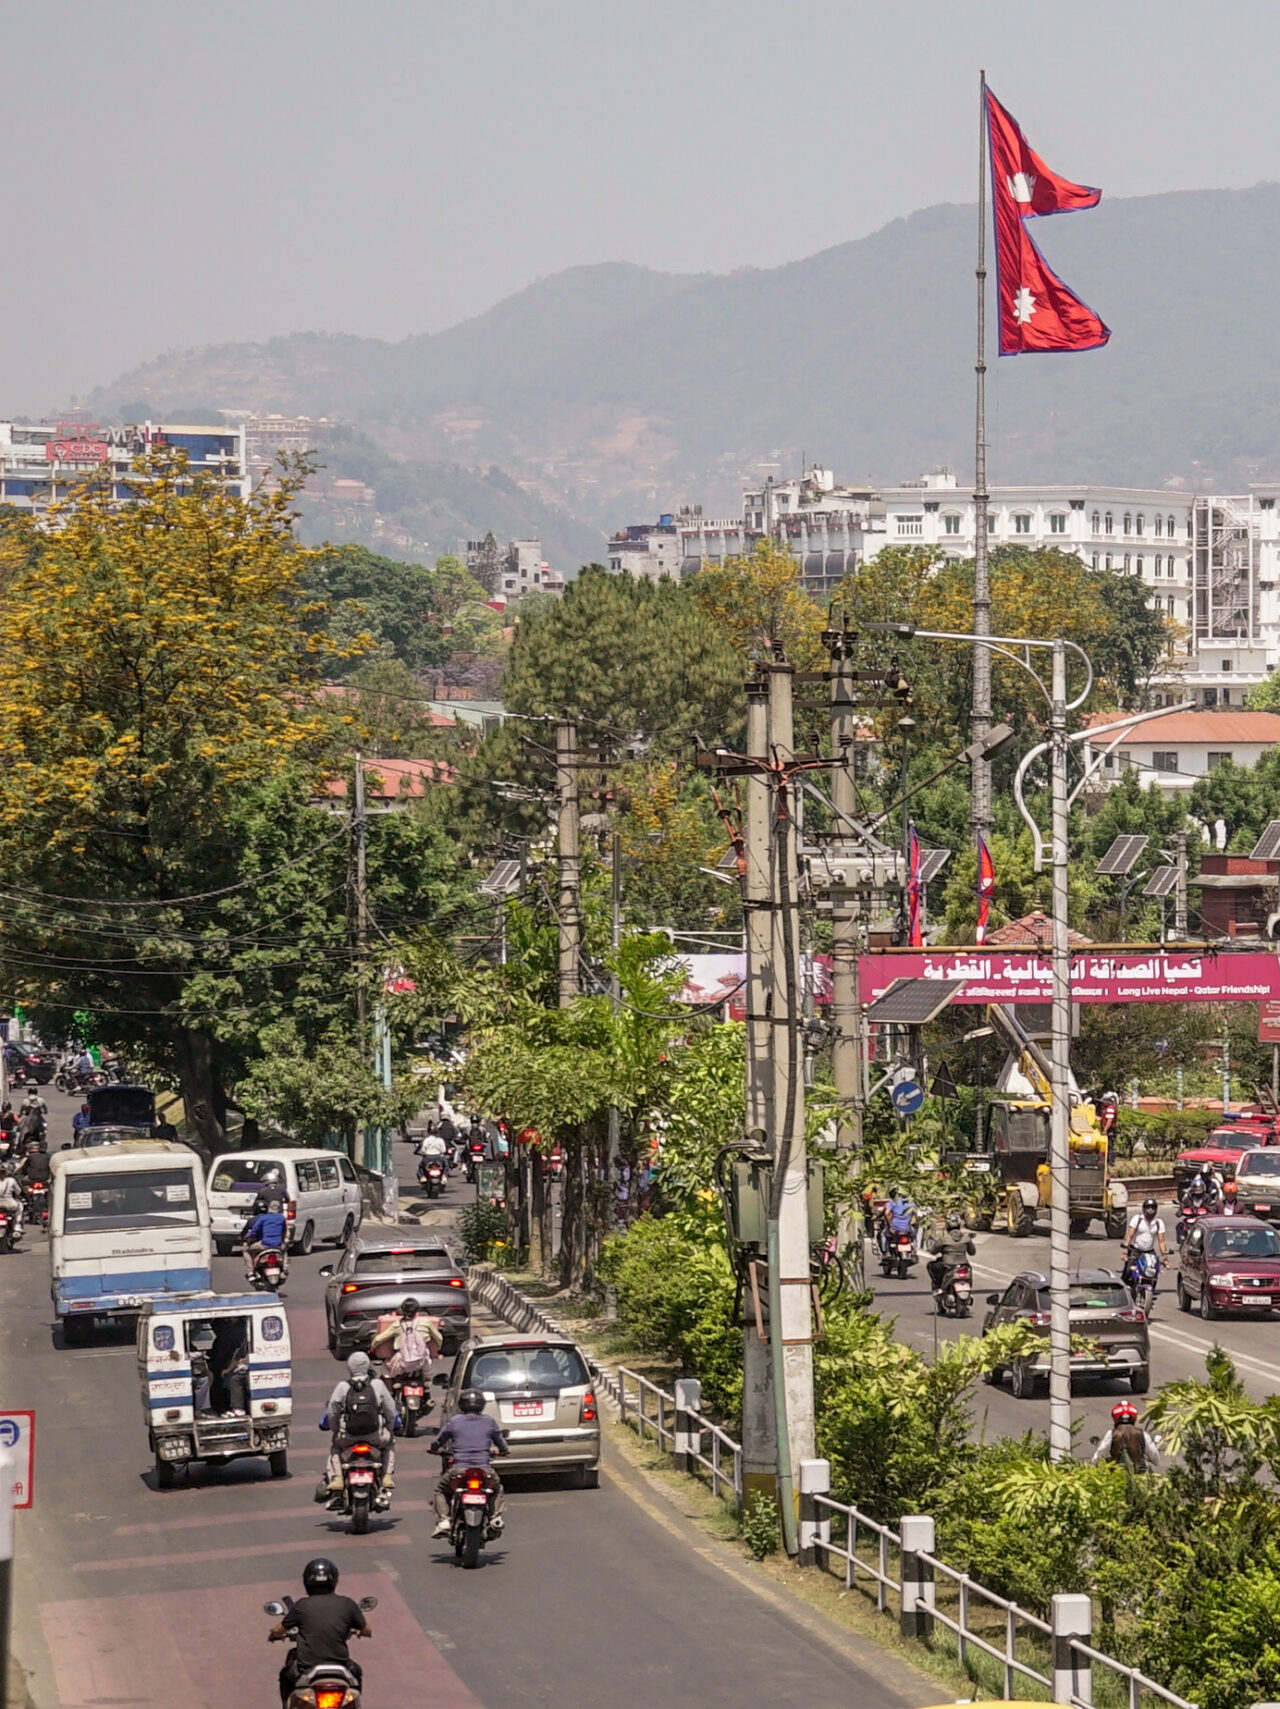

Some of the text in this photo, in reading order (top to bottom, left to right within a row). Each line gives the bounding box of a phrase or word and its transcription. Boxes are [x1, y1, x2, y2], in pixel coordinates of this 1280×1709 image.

[56, 423, 166, 446] CTC MALL
[71, 444, 101, 454] CDC
[1163, 959, 1202, 983] تحيا
[1118, 986, 1141, 997] Long
[1142, 986, 1160, 996] Live
[1162, 986, 1188, 996] Nepal
[1194, 985, 1220, 995] Qatar
[1221, 984, 1271, 995] Friendship!
